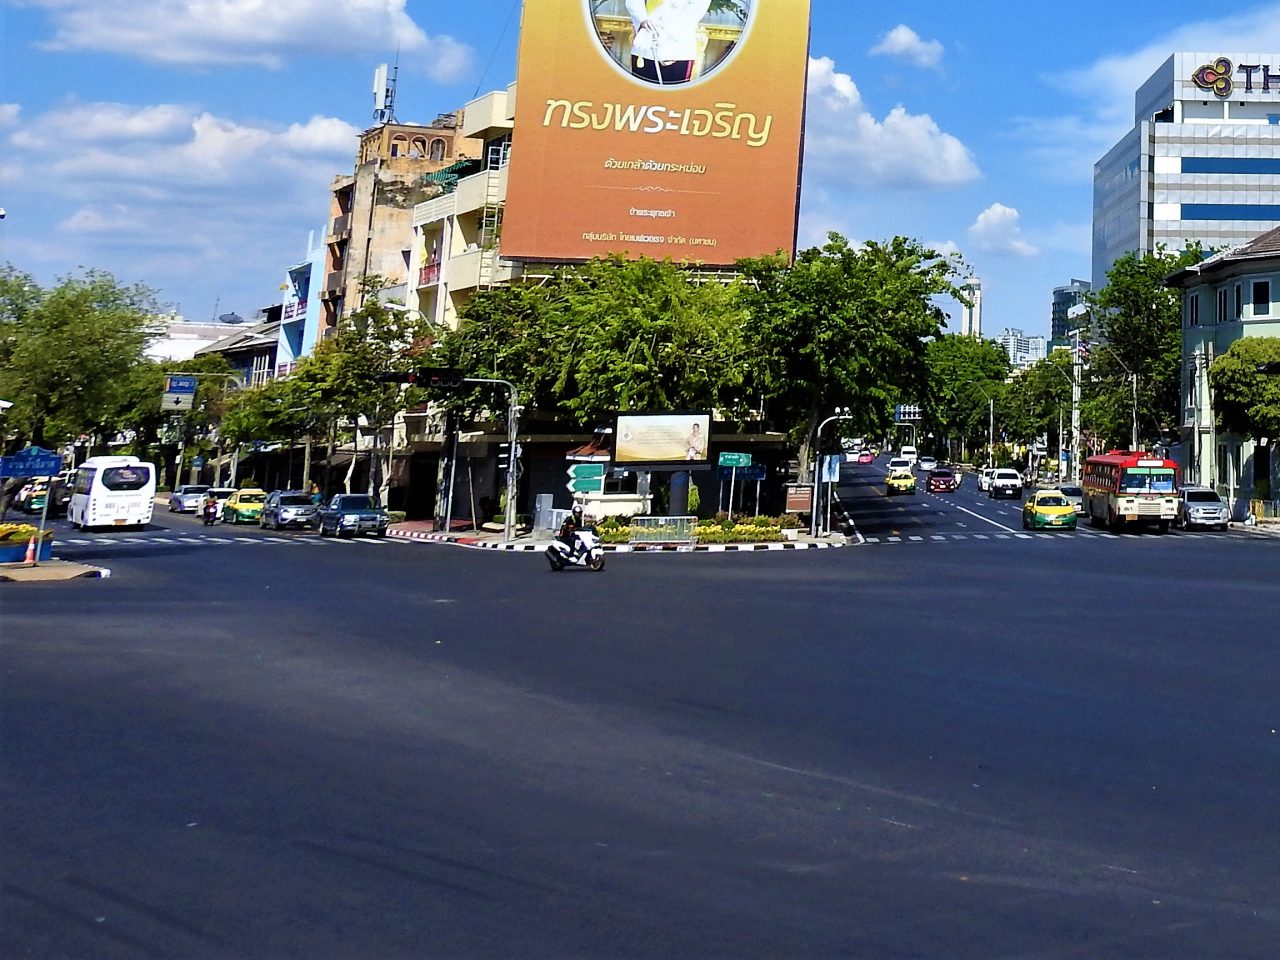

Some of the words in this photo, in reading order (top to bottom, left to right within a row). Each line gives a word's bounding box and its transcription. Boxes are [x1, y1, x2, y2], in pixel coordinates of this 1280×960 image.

[543, 99, 773, 147] ทรงพระเจริญ
[604, 157, 706, 174] ด้วยเกล้าด้วยกระหม่อม
